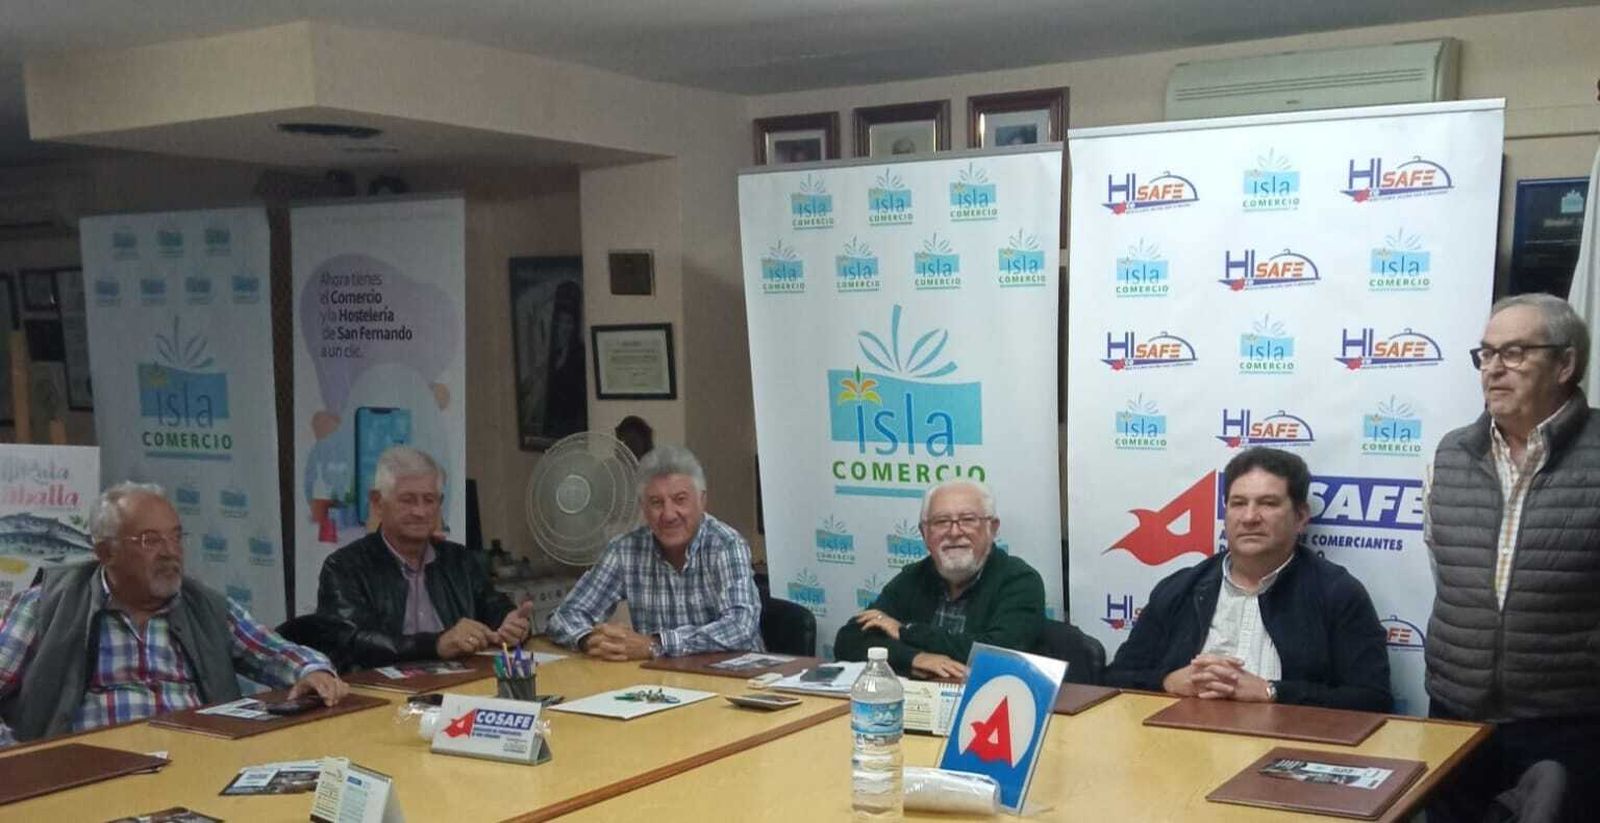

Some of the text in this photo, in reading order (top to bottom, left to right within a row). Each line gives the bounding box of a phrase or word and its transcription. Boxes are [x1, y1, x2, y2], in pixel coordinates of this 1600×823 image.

[1252, 175, 1291, 195] isla
[798, 196, 828, 217] isla
[875, 192, 906, 213] isla
[957, 187, 990, 208] isla
[1242, 197, 1300, 208] COMERCIO
[791, 217, 835, 226] COMERCIO
[868, 213, 914, 222] COMERCIO
[949, 208, 998, 218] COMERCIO
[769, 262, 798, 282] isla
[841, 259, 873, 279] isla
[920, 257, 952, 276] isla
[1005, 254, 1038, 274] isla
[1380, 255, 1420, 277] isla
[914, 277, 962, 286] COMERCIO
[998, 275, 1047, 284] COMERCIO
[1124, 264, 1160, 285] isla
[1369, 278, 1431, 287] COMERCIO
[762, 283, 806, 291] COMERCIO
[835, 279, 881, 289] COMERCIO
[1115, 285, 1169, 294] COMERCIO
[330, 289, 382, 304] Comercio
[337, 326, 358, 340] San
[360, 326, 413, 340] Fernando
[1248, 341, 1285, 362] isla
[1239, 362, 1295, 371] COMERCIO
[157, 381, 214, 428] isla
[856, 392, 955, 458] isla
[1123, 417, 1159, 438] isla
[1373, 421, 1412, 443] isla
[142, 431, 233, 450] COMERCIO
[1114, 438, 1168, 447] COMERCIO
[1361, 442, 1422, 453] COMERCIO
[1311, 533, 1403, 551] COMERCIANTES
